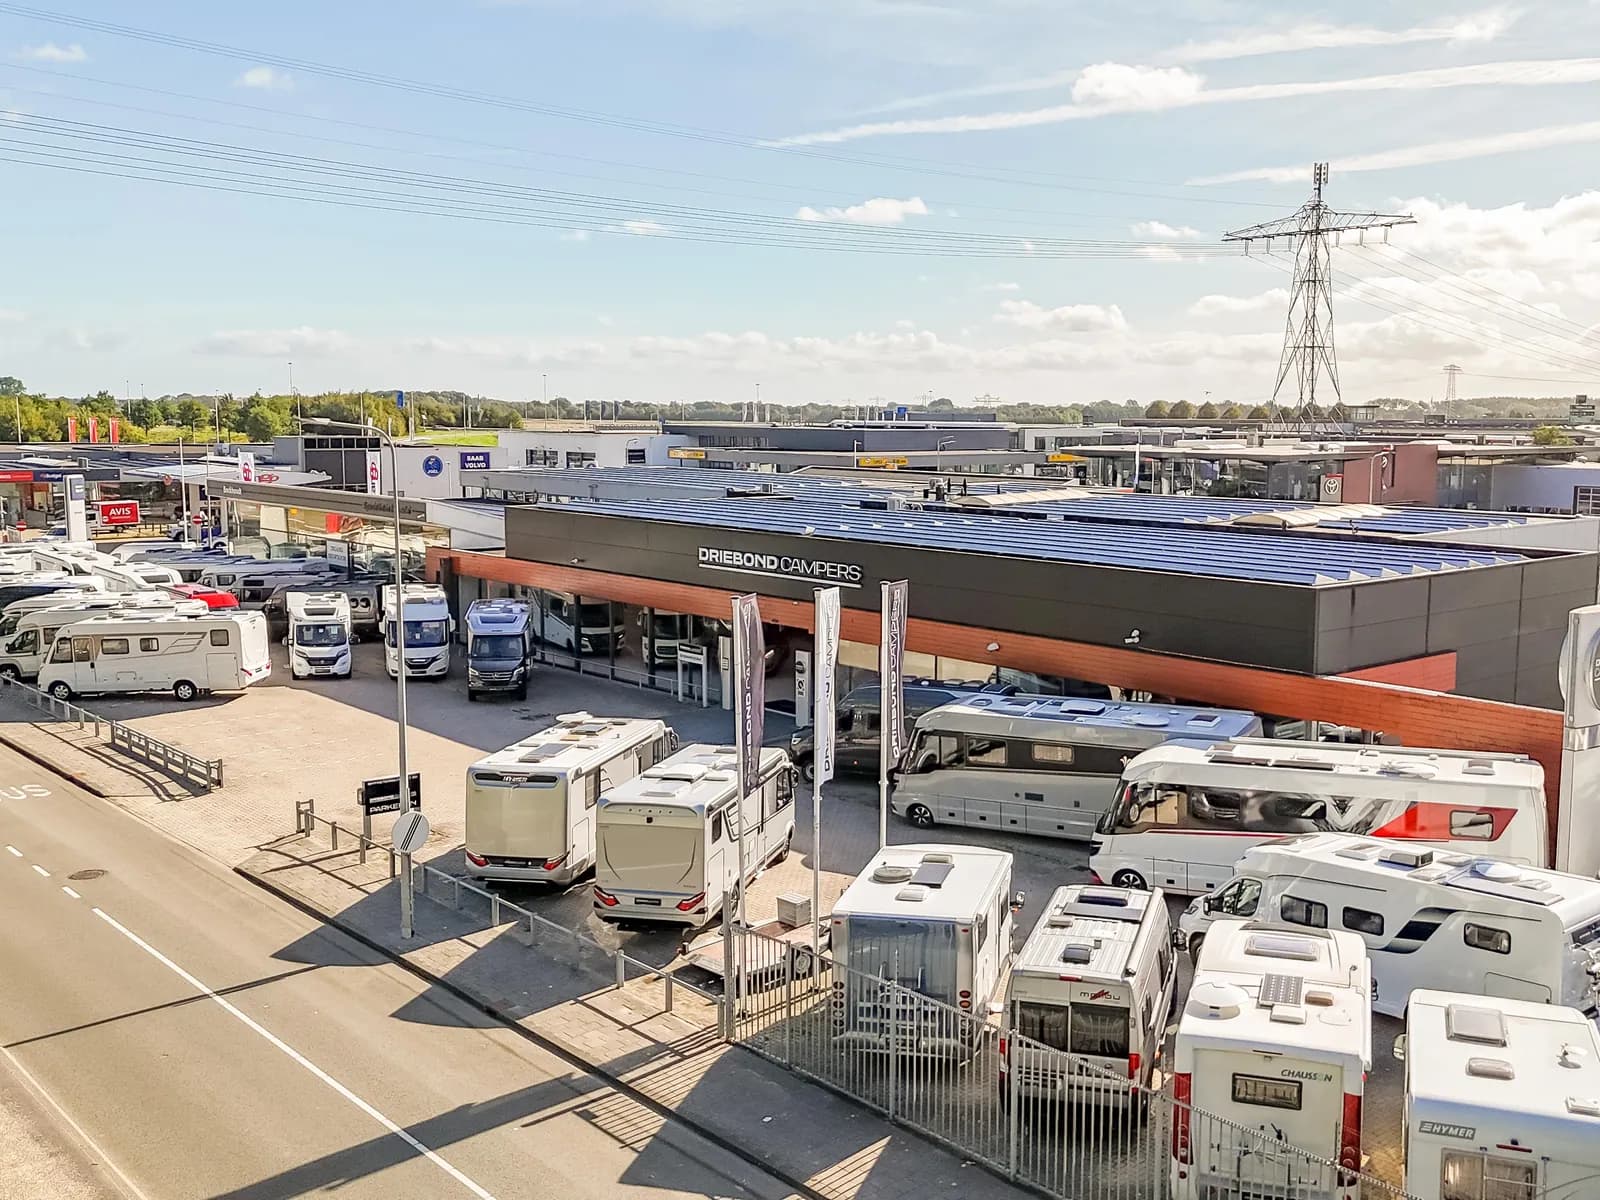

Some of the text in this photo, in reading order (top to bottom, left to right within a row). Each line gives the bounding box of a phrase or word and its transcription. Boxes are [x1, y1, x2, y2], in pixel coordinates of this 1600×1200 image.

[109, 507, 132, 516] AVIS
[698, 547, 863, 582] DRIEBOND CAMPERS
[0, 784, 52, 801] US
[1079, 989, 1121, 1001] mabu
[1431, 1123, 1475, 1139] HYMER
